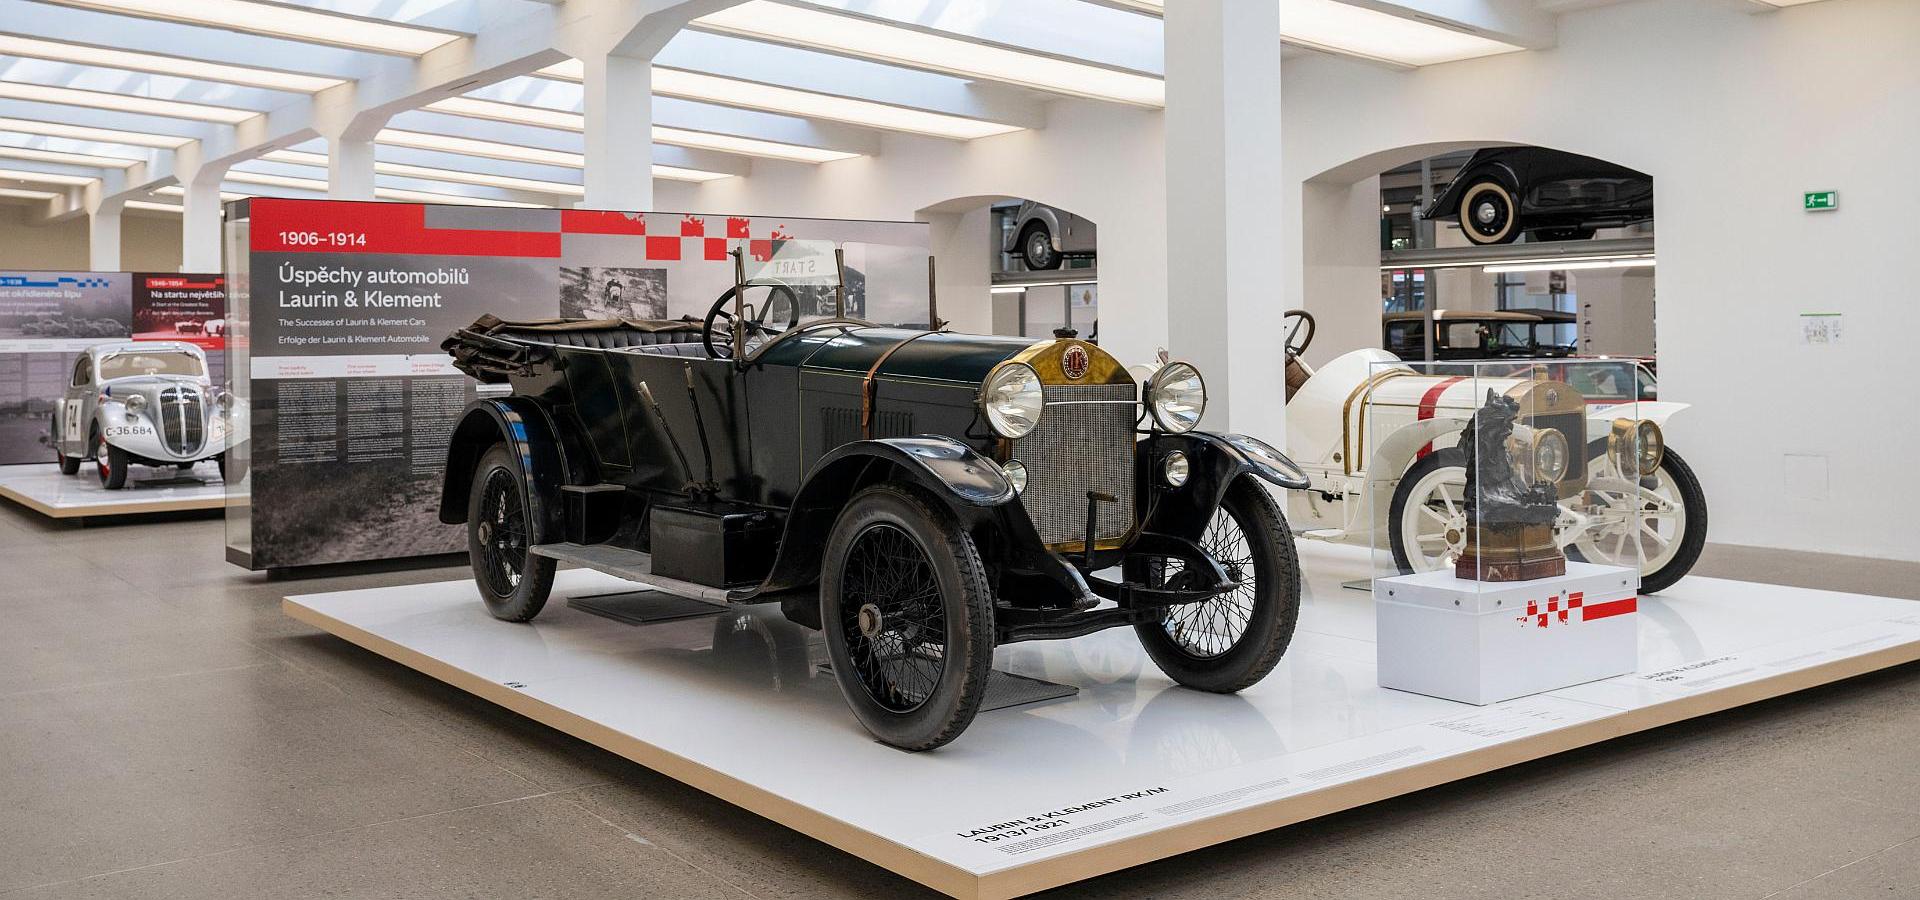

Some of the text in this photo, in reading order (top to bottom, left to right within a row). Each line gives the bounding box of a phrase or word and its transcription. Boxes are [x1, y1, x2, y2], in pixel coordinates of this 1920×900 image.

[279, 261, 469, 287] Úspěchy automobilů
[150, 290, 163, 299] Na
[164, 291, 188, 299] startu
[279, 290, 442, 308] Laurin & Klement
[278, 318, 426, 327] The Successes of Laurin & Klement Cars
[278, 335, 430, 346] Erfolge der Laurin & Klement Automobile
[957, 819, 1027, 839] LAURIN
[1042, 797, 1121, 820] KLEMENT
[974, 818, 1071, 845] 1913/1921
